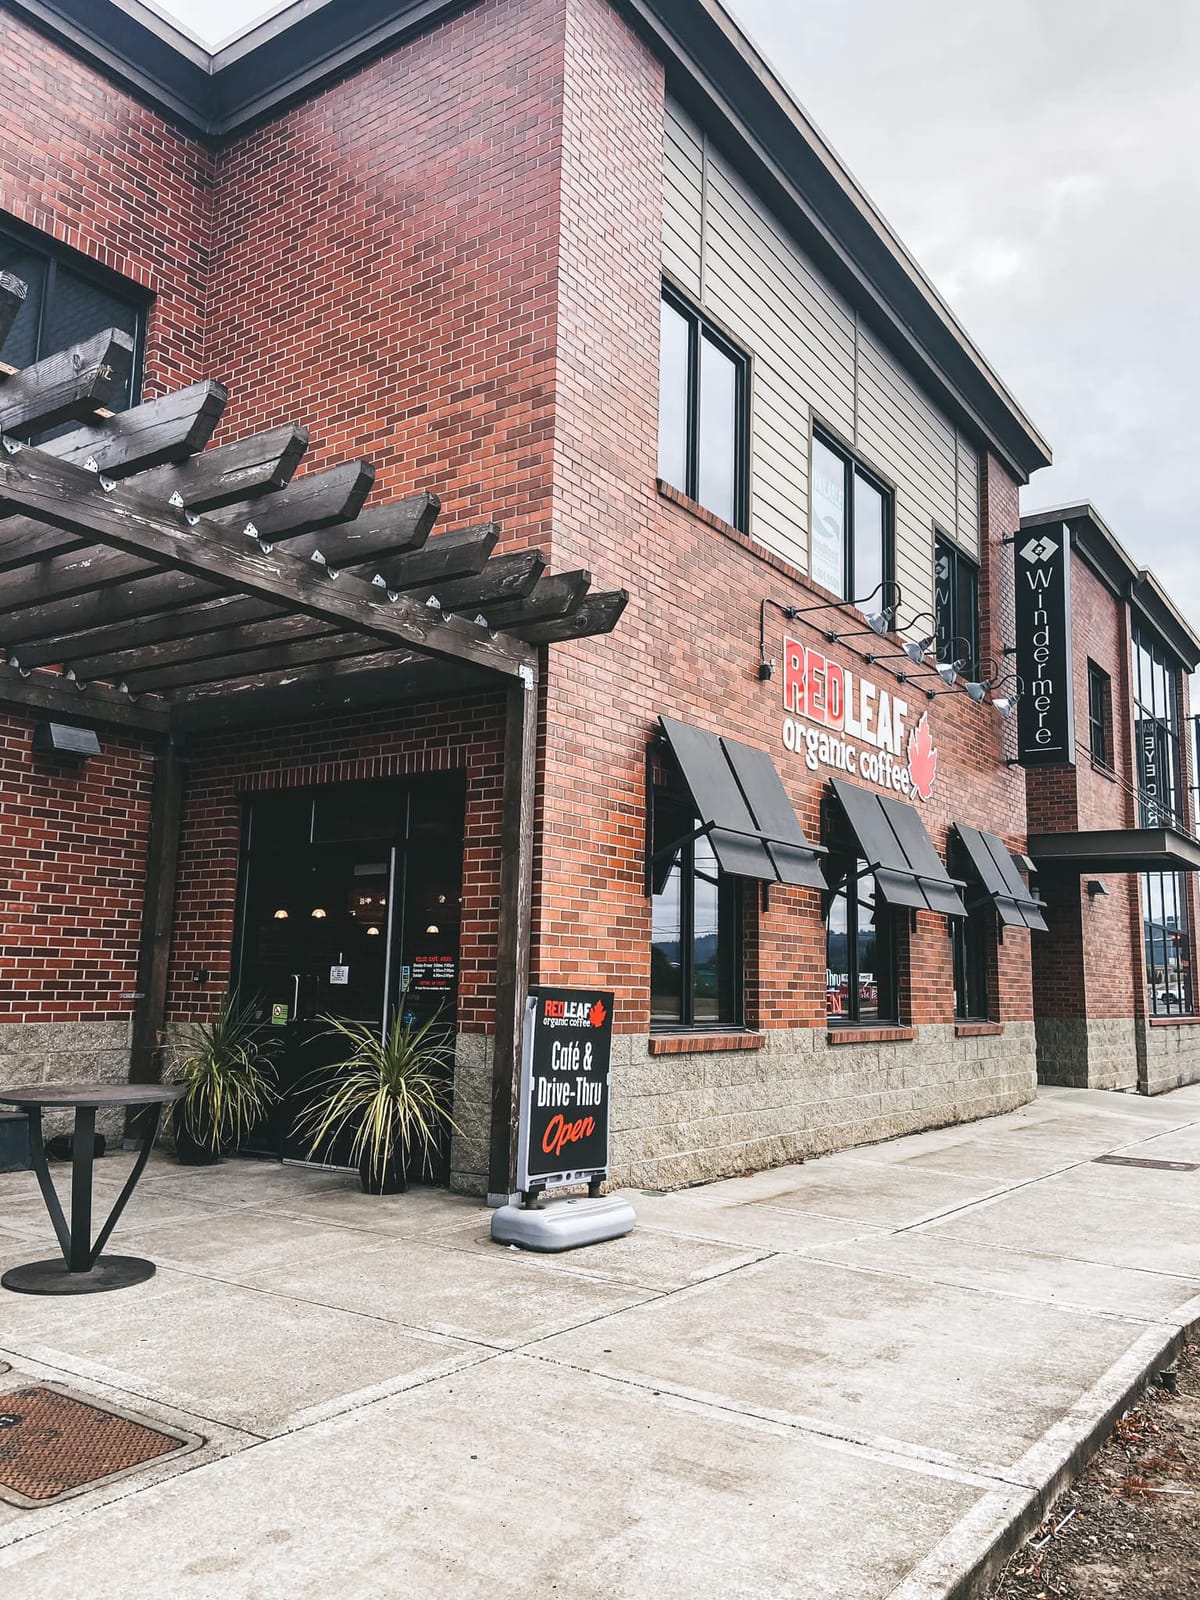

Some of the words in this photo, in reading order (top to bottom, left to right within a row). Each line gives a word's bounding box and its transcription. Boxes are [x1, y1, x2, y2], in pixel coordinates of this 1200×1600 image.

[1026, 566, 1053, 744] Windermere
[783, 717, 856, 771] organic
[860, 750, 910, 795] coffee
[543, 1017, 569, 1028] organic
[569, 1017, 591, 1028] coffee
[551, 1040, 581, 1072] Café
[583, 1041, 593, 1072] &
[537, 1076, 602, 1108] Drive-Thru
[542, 1113, 596, 1157] Open
